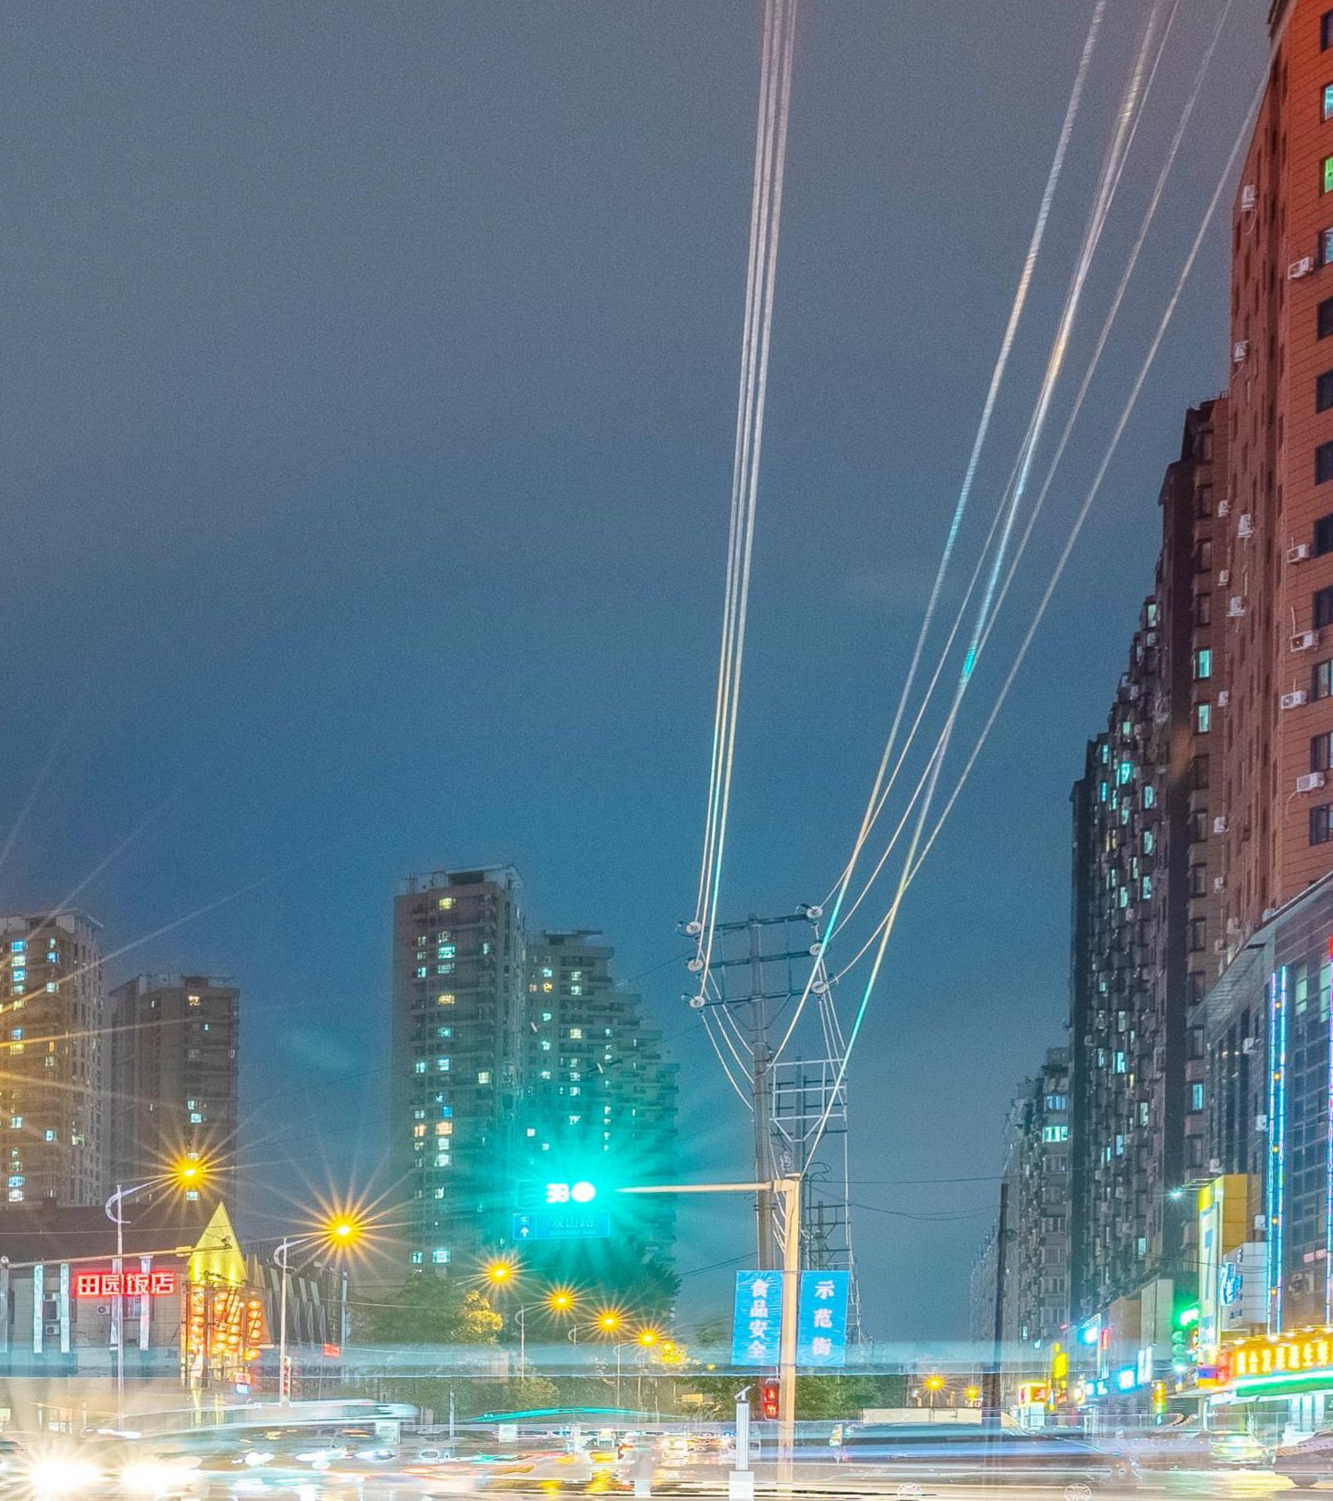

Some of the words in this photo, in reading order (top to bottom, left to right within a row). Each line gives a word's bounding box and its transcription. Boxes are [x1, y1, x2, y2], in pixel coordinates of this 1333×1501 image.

[78, 1273, 174, 1295] 田园饭店
[747, 1278, 770, 1359] 食品安全
[811, 1280, 836, 1357] 示范街
